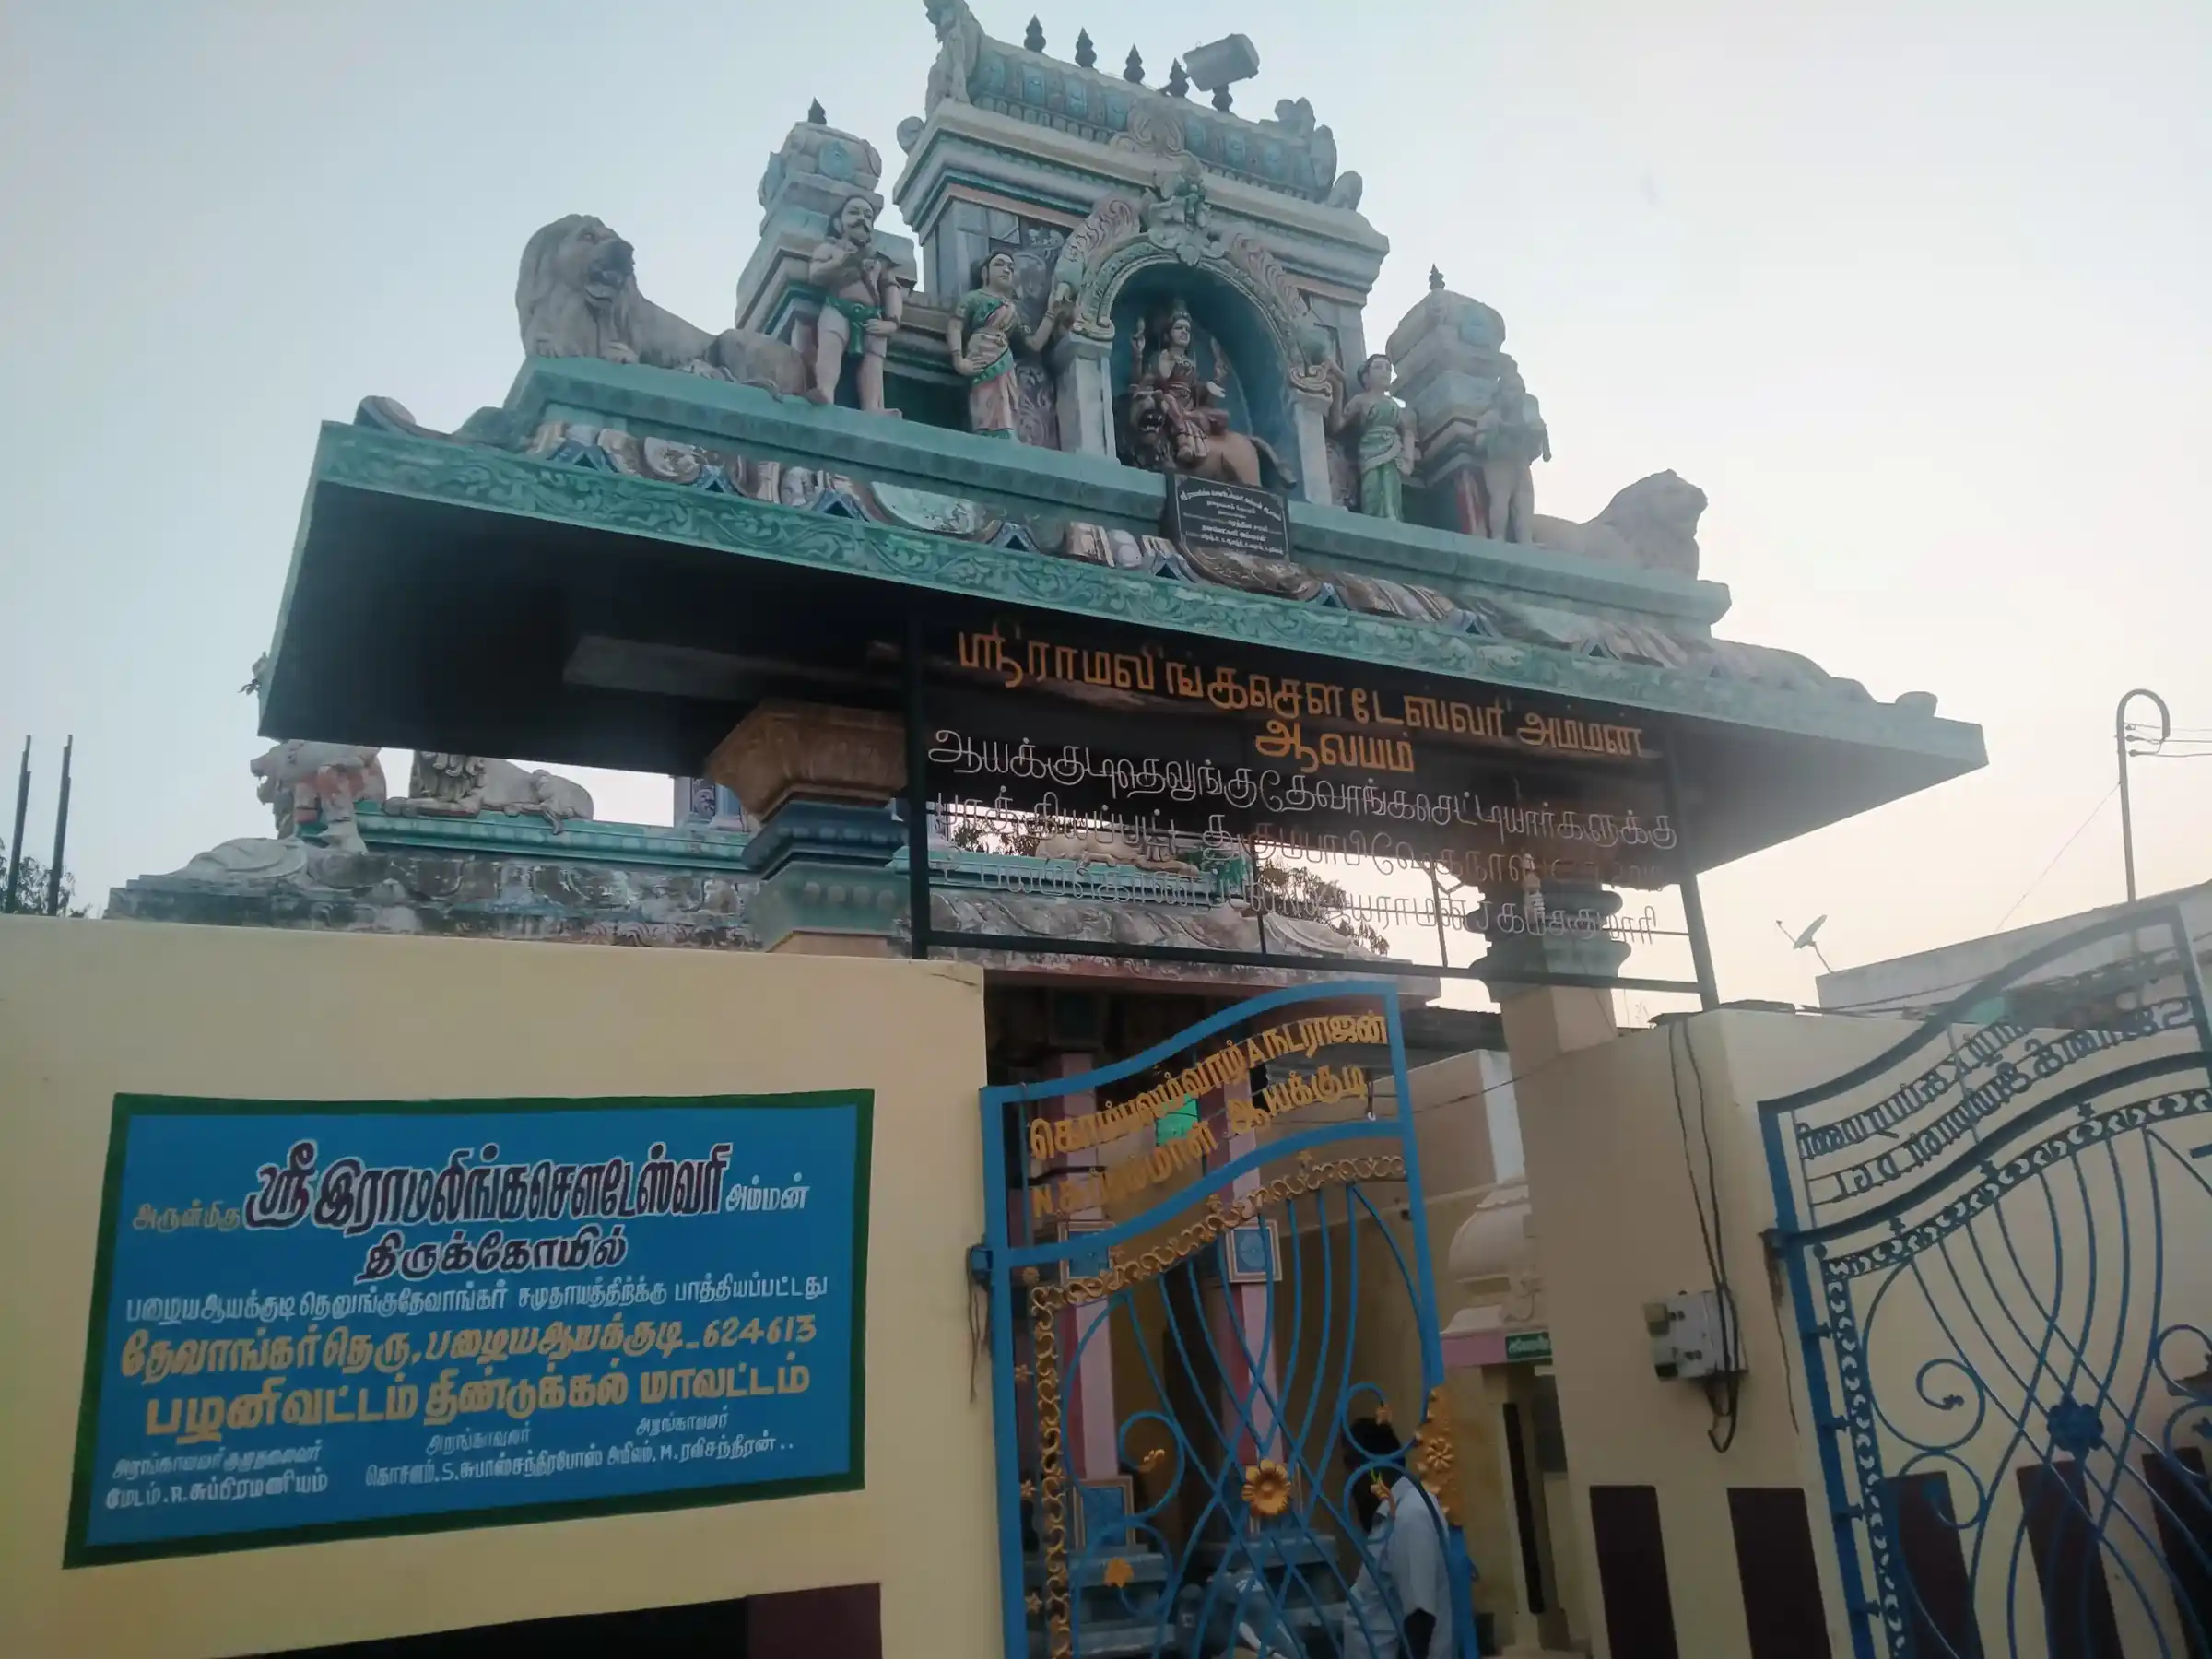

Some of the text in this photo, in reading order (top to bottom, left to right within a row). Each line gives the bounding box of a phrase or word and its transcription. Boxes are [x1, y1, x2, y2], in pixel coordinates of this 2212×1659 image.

[1261, 1009, 1390, 1059] நடராஜன்
[725, 1171, 811, 1214] அம்மன்
[354, 1223, 628, 1285] திருக்கோயில்
[702, 1313, 818, 1348] 624613
[640, 1351, 811, 1406] மாவட்டம்
